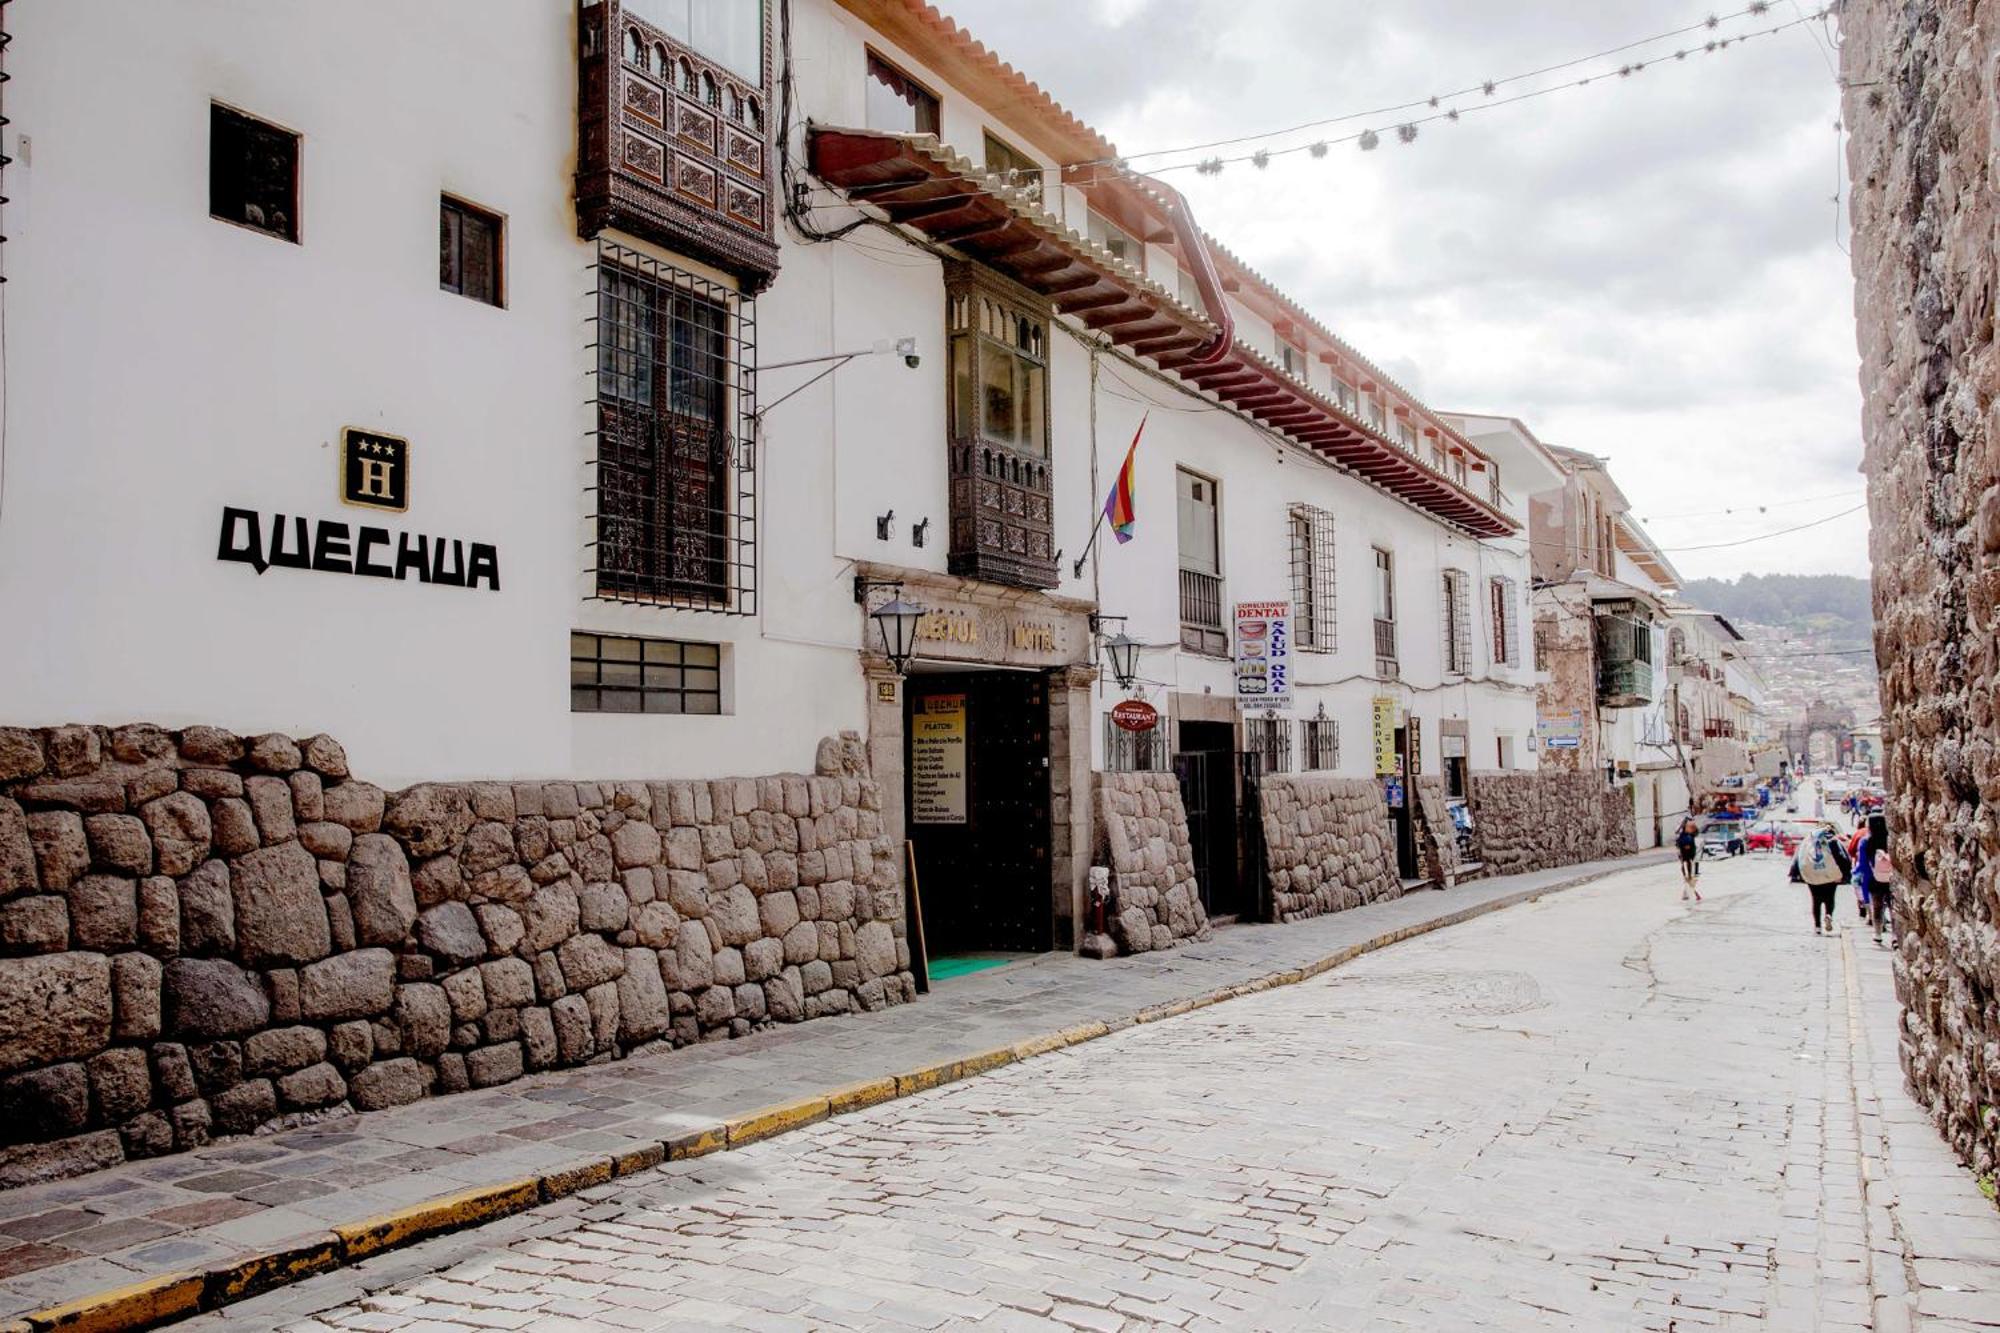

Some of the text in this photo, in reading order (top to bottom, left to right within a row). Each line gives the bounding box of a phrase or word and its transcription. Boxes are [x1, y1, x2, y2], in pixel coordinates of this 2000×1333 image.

[357, 456, 395, 499] H
[217, 506, 500, 591] QUECHUA
[1238, 608, 1288, 618] DENTAL
[1271, 664, 1286, 693] ORAL
[1374, 706, 1383, 769] BORDADOS
